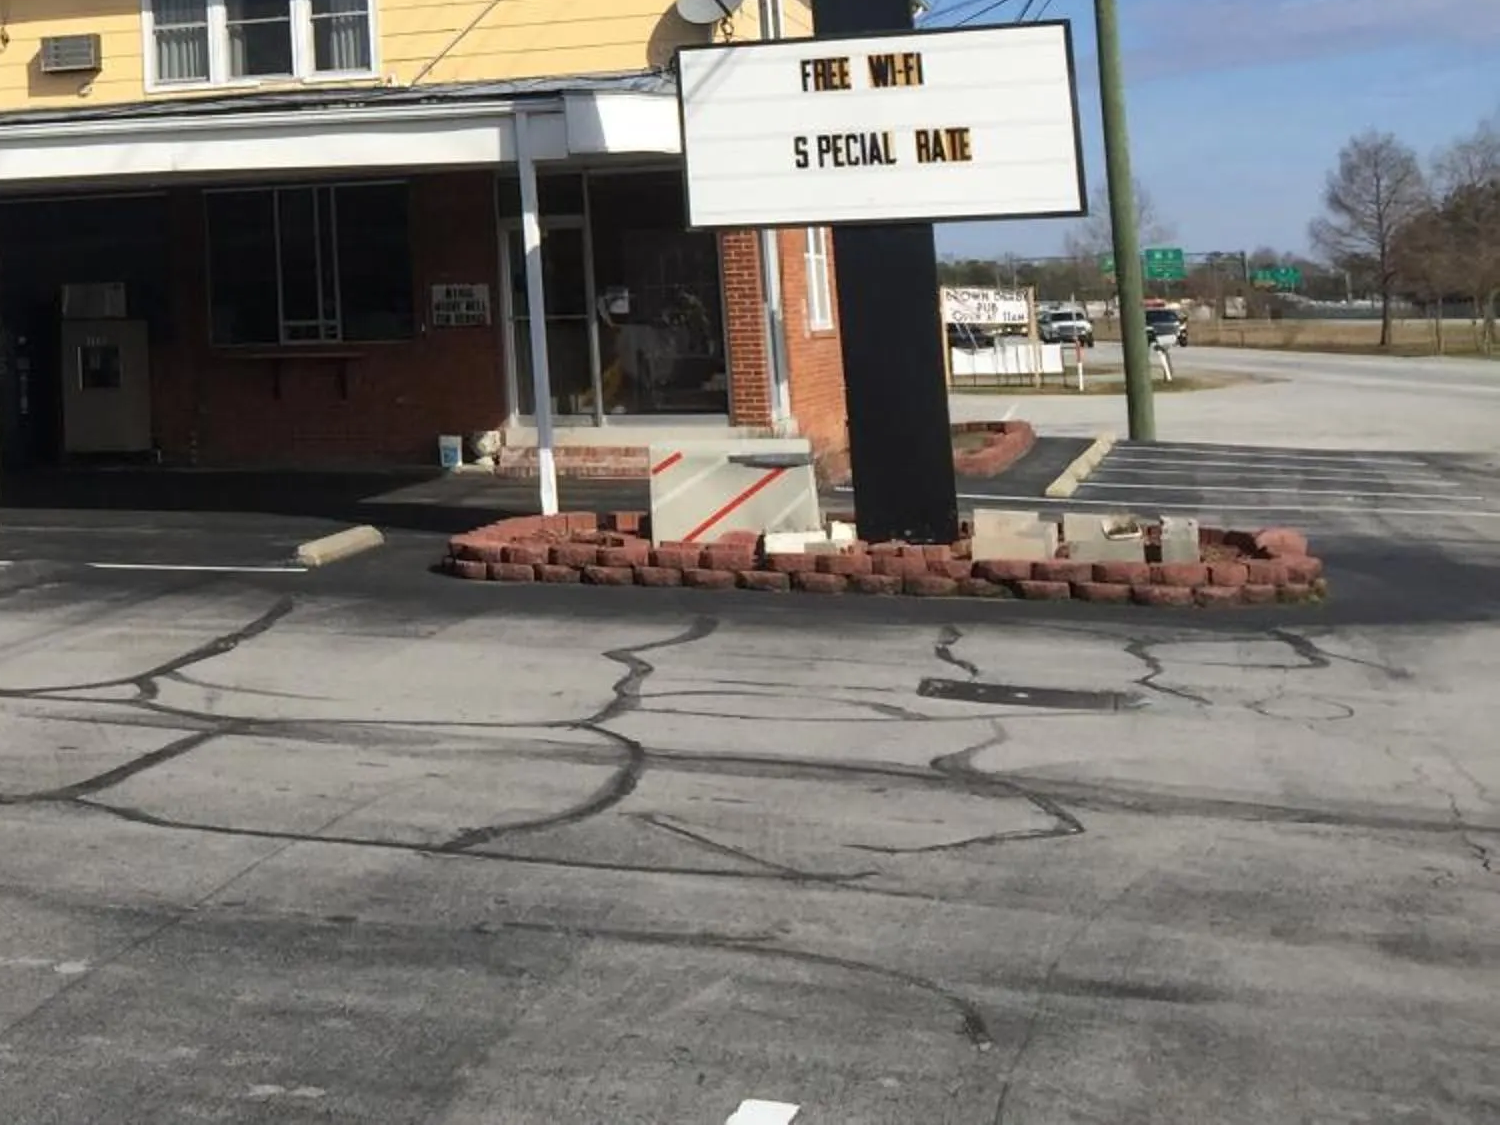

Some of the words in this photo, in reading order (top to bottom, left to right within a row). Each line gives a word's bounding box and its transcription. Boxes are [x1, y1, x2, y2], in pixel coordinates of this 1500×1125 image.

[800, 56, 852, 92] FREE
[867, 51, 925, 88] WI-FI
[915, 126, 973, 164] RATE
